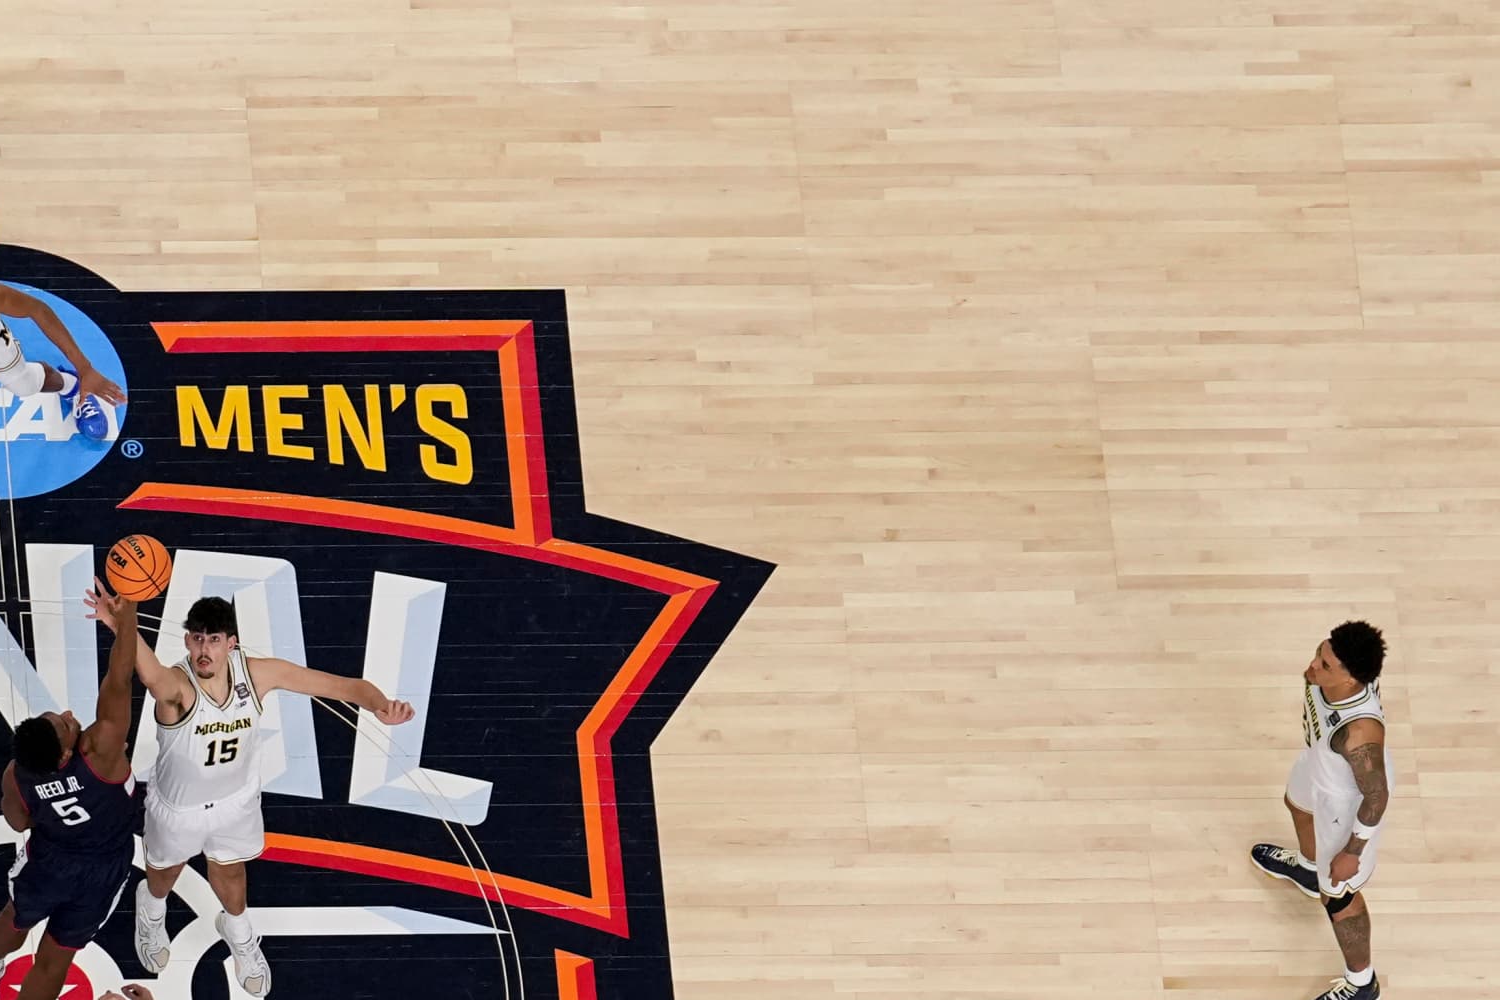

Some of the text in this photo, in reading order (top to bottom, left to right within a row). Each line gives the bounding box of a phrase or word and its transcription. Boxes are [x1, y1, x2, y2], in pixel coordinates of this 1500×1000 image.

[175, 383, 474, 485] MEN'S
[194, 717, 252, 735] MICHIGAN
[203, 737, 239, 767] 15
[34, 775, 85, 800] REED JR.
[51, 796, 92, 826] 5
